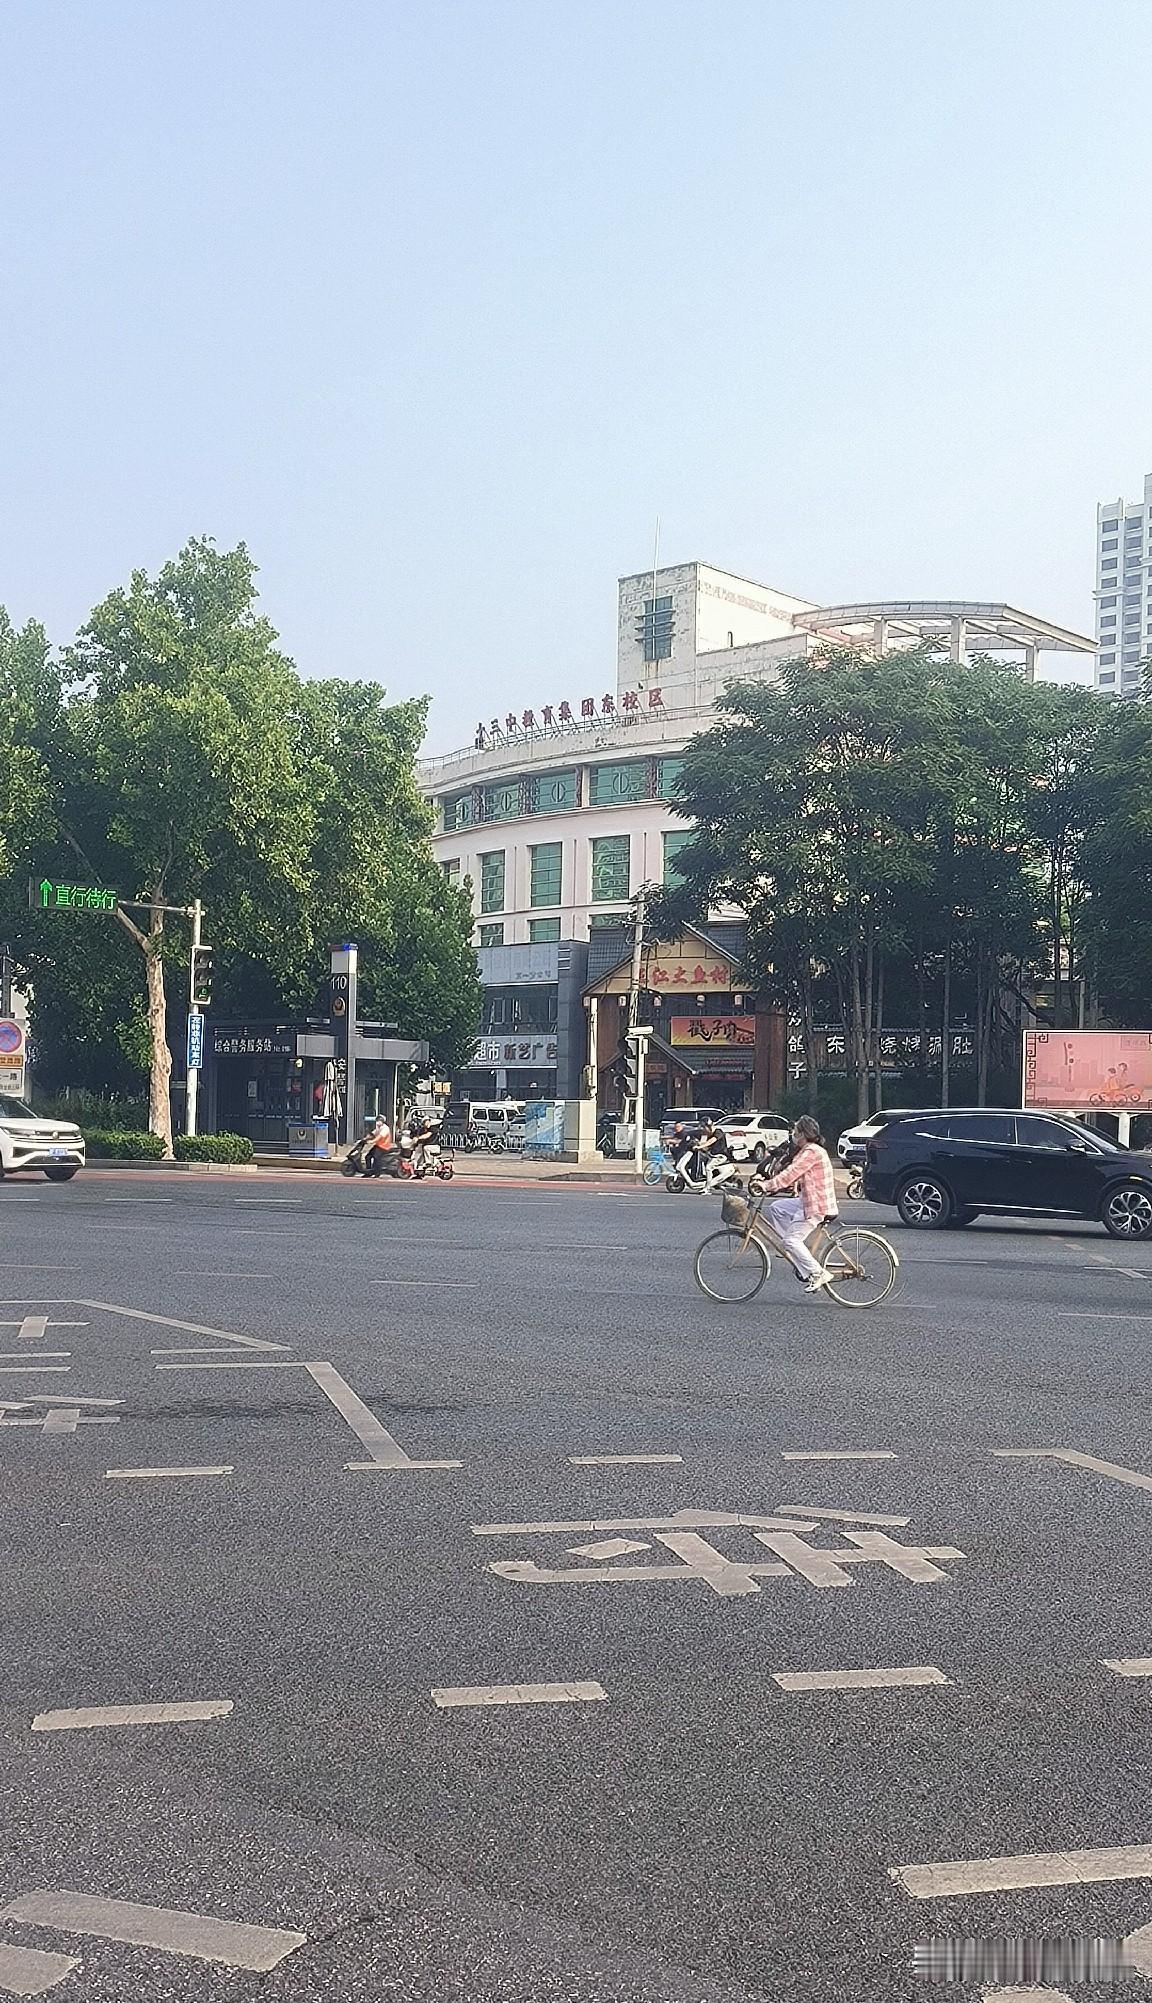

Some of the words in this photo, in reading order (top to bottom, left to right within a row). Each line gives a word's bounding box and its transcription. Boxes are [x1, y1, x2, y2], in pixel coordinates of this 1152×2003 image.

[55, 884, 117, 909] 直行待行
[331, 975, 347, 990] 110
[214, 1038, 272, 1053] 综合警务服务站
